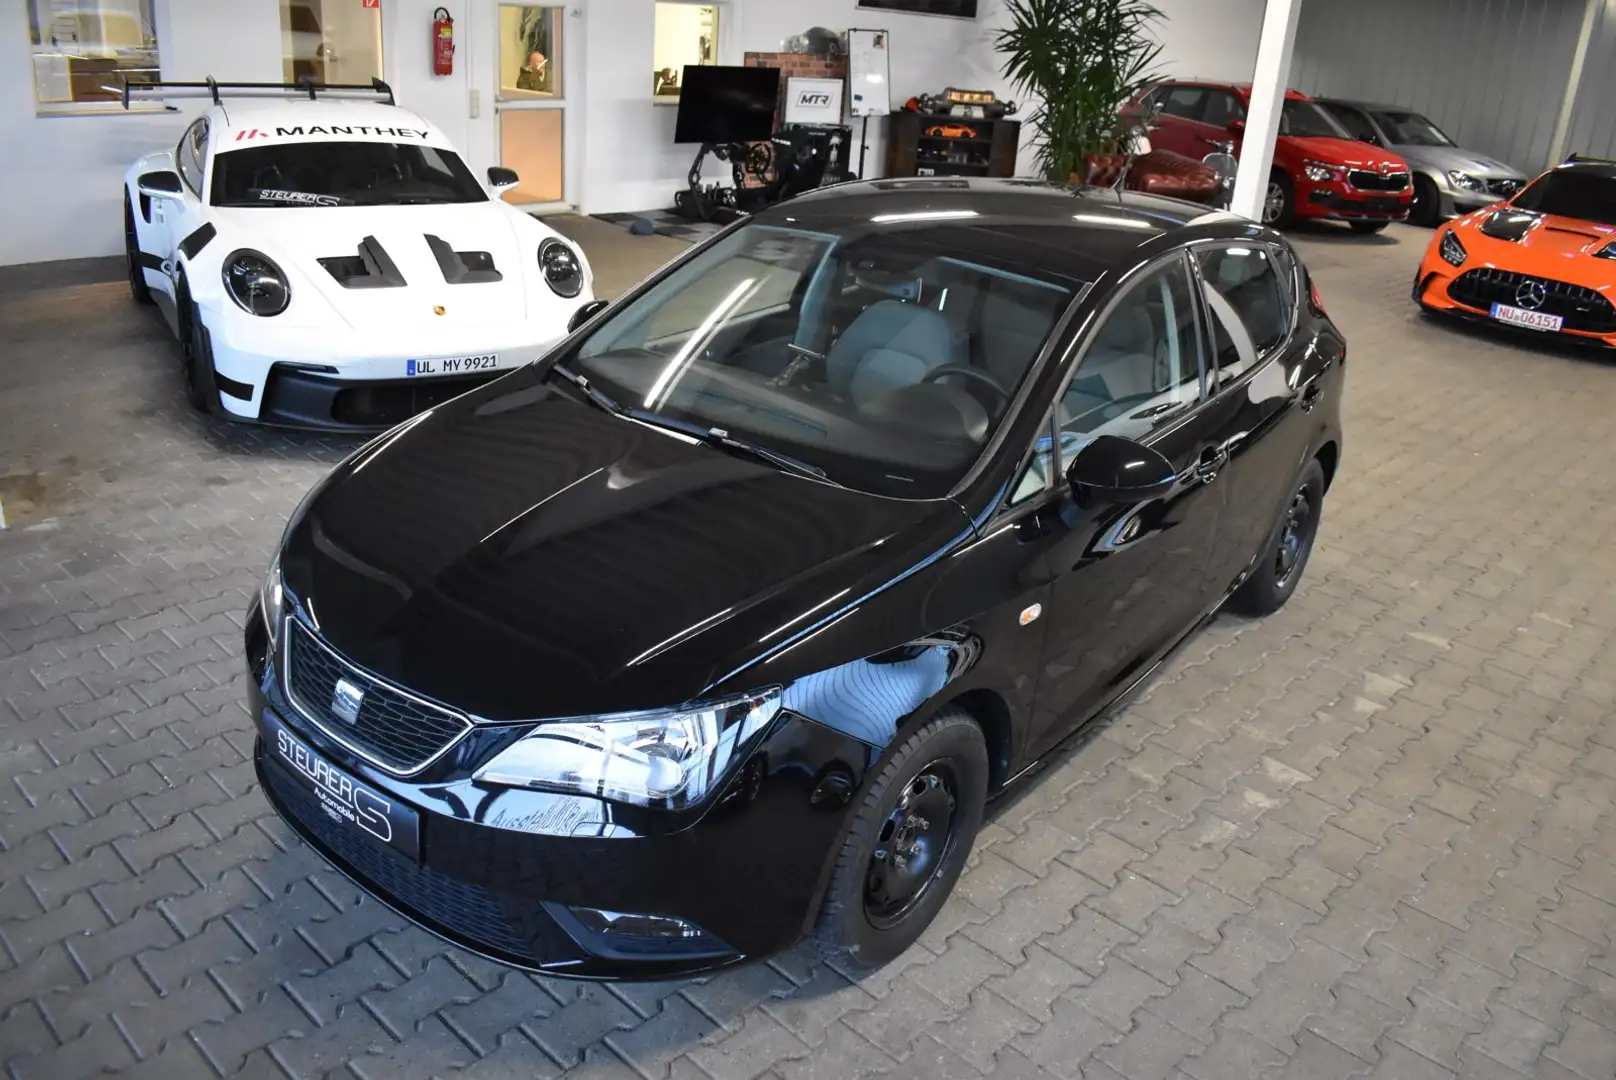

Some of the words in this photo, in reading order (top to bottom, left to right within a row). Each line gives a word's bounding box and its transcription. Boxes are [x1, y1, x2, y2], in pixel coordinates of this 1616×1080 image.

[800, 94, 830, 105] MTR
[275, 126, 429, 139] MANTHEY
[259, 189, 318, 203] STEURER
[1499, 306, 1515, 320] NU
[1520, 311, 1558, 330] 06151
[417, 360, 435, 374] UL
[464, 355, 497, 370] 9921
[277, 729, 353, 802] STEURER
[314, 786, 355, 822] Automobile
